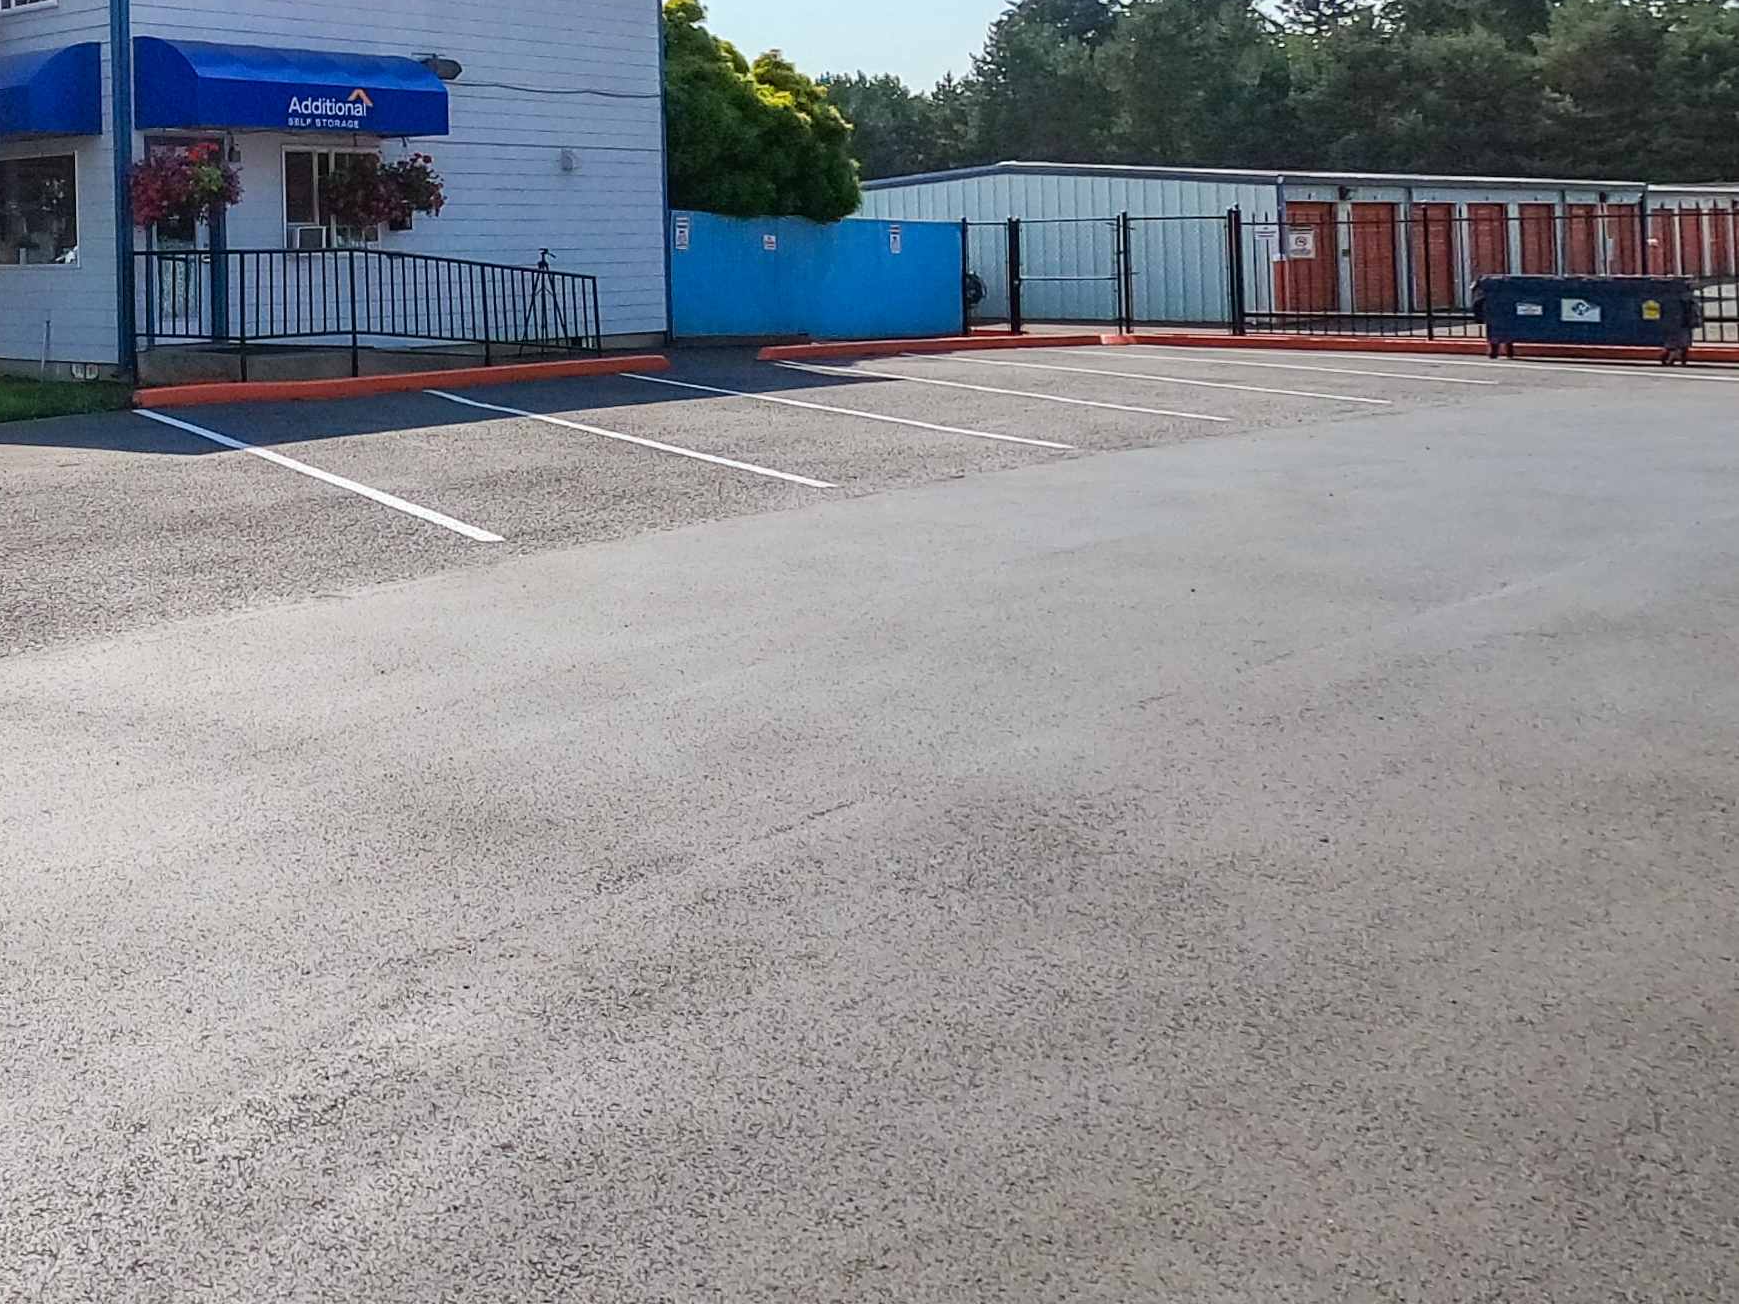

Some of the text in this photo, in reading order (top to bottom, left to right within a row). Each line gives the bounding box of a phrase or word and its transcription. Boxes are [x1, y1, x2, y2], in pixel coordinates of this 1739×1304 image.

[288, 96, 367, 117] Additional
[288, 117, 359, 129] SELF STORAGE
